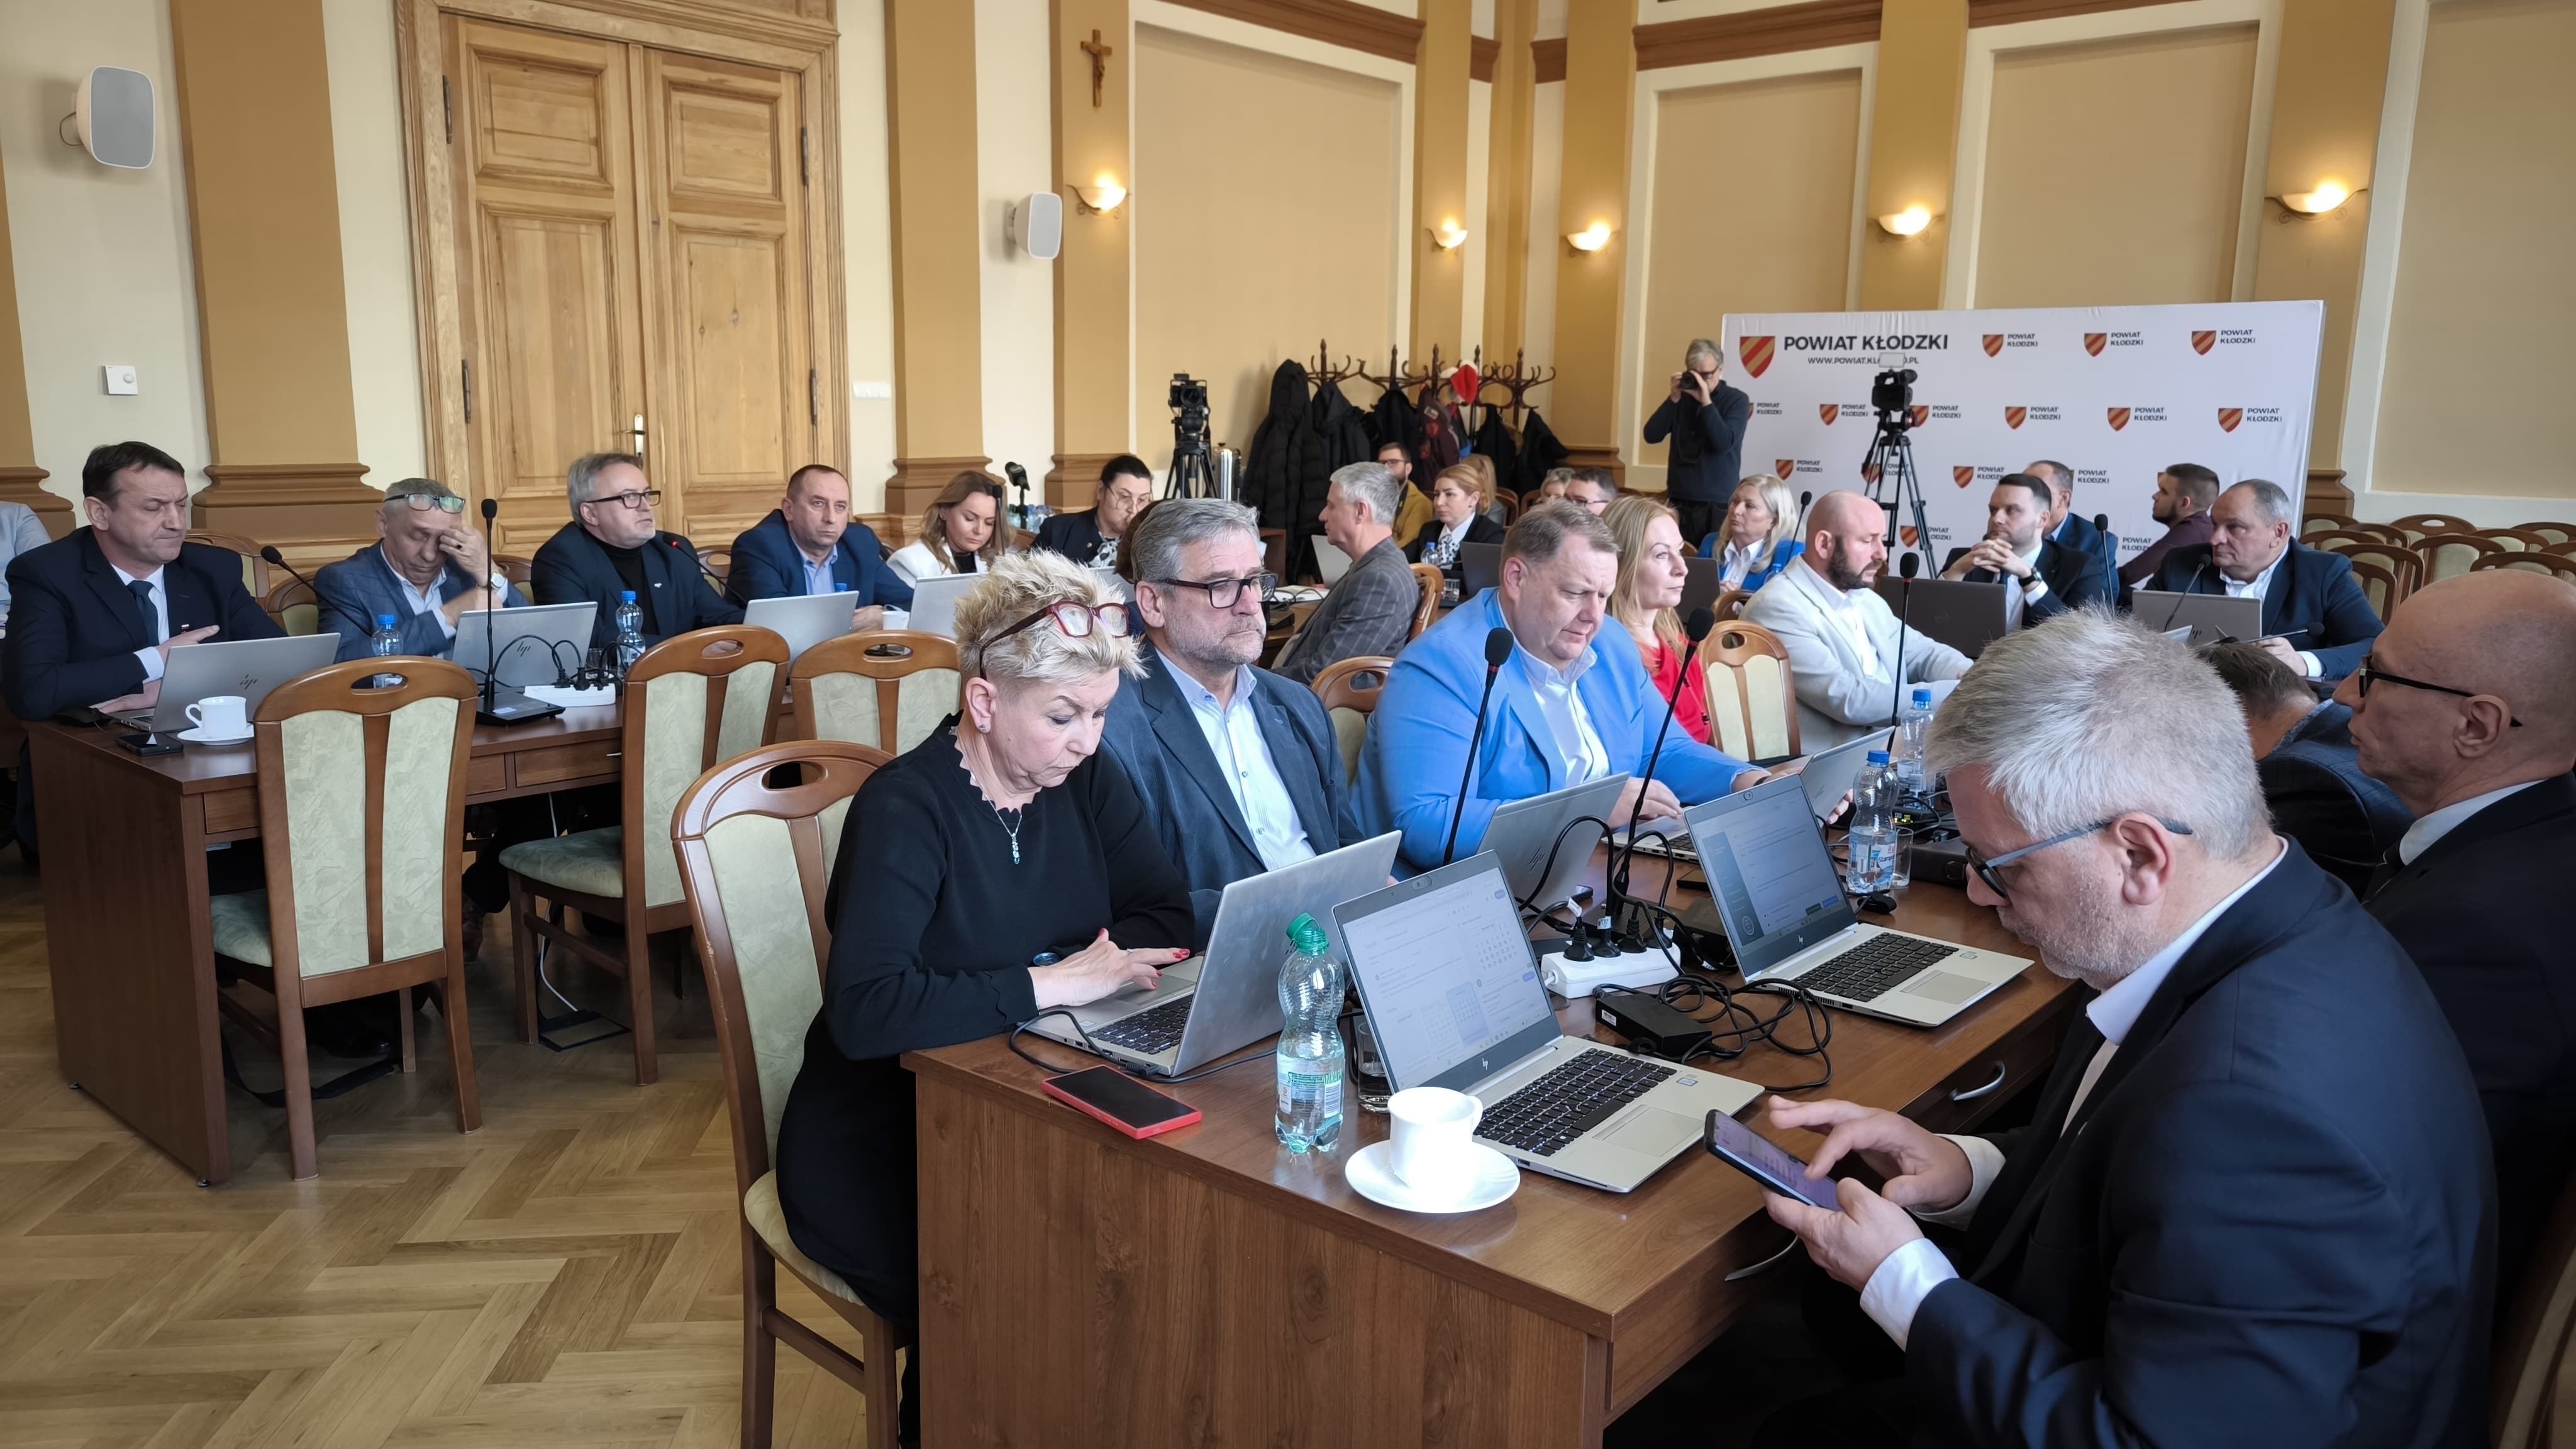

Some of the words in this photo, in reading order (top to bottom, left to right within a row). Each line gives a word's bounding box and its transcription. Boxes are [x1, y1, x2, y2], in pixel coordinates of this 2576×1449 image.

[1784, 336, 1857, 350] POWIAT
[1862, 335, 1948, 350] KŁODZKI
[2122, 536, 2152, 545] POWIAT
